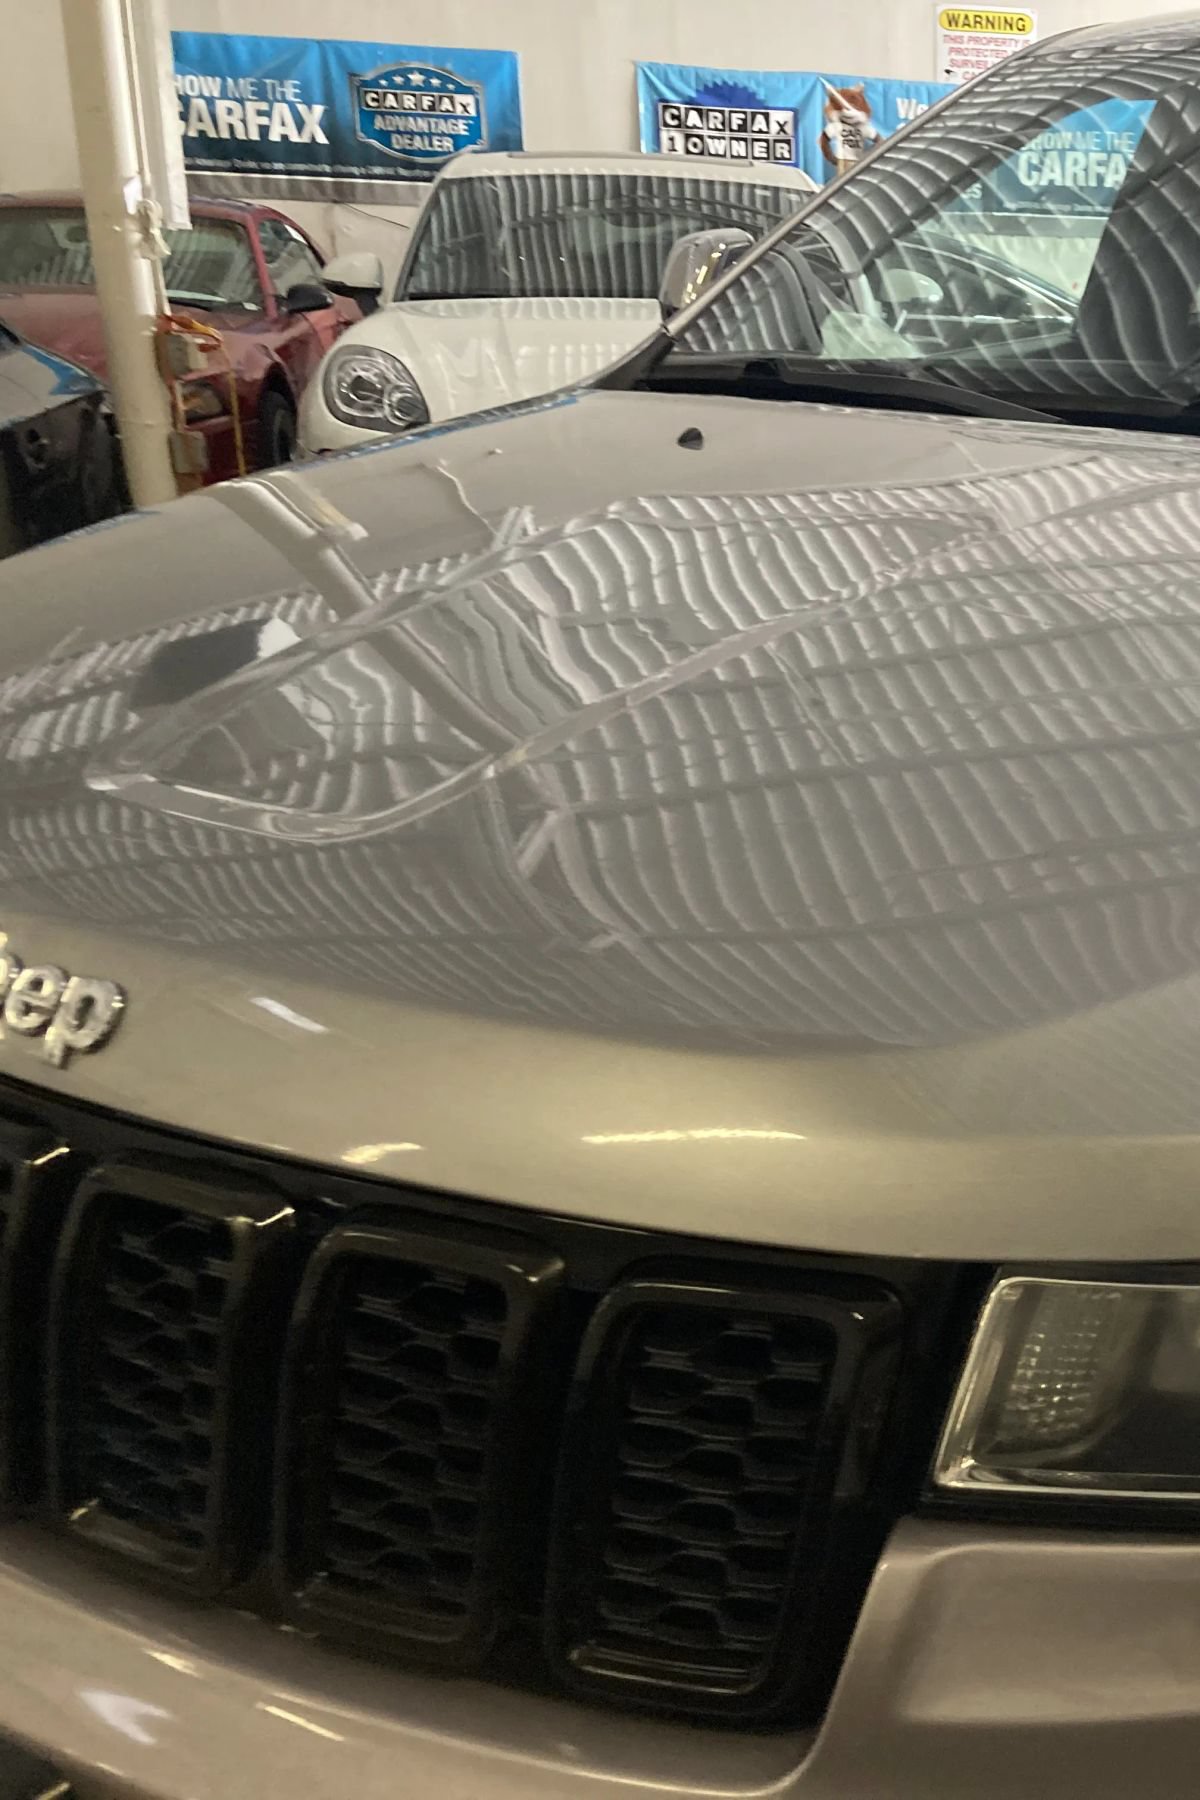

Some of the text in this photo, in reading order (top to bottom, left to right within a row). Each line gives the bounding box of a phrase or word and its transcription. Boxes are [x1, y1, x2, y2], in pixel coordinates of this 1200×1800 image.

[946, 12, 1026, 32] WARNING
[174, 74, 303, 102] HOW ME THE
[364, 90, 474, 115] CARFAX
[662, 105, 791, 135] CARFAX
[390, 132, 455, 153] DEALER
[667, 134, 792, 160] 1 OWNER
[1017, 150, 1136, 190] CARFA
